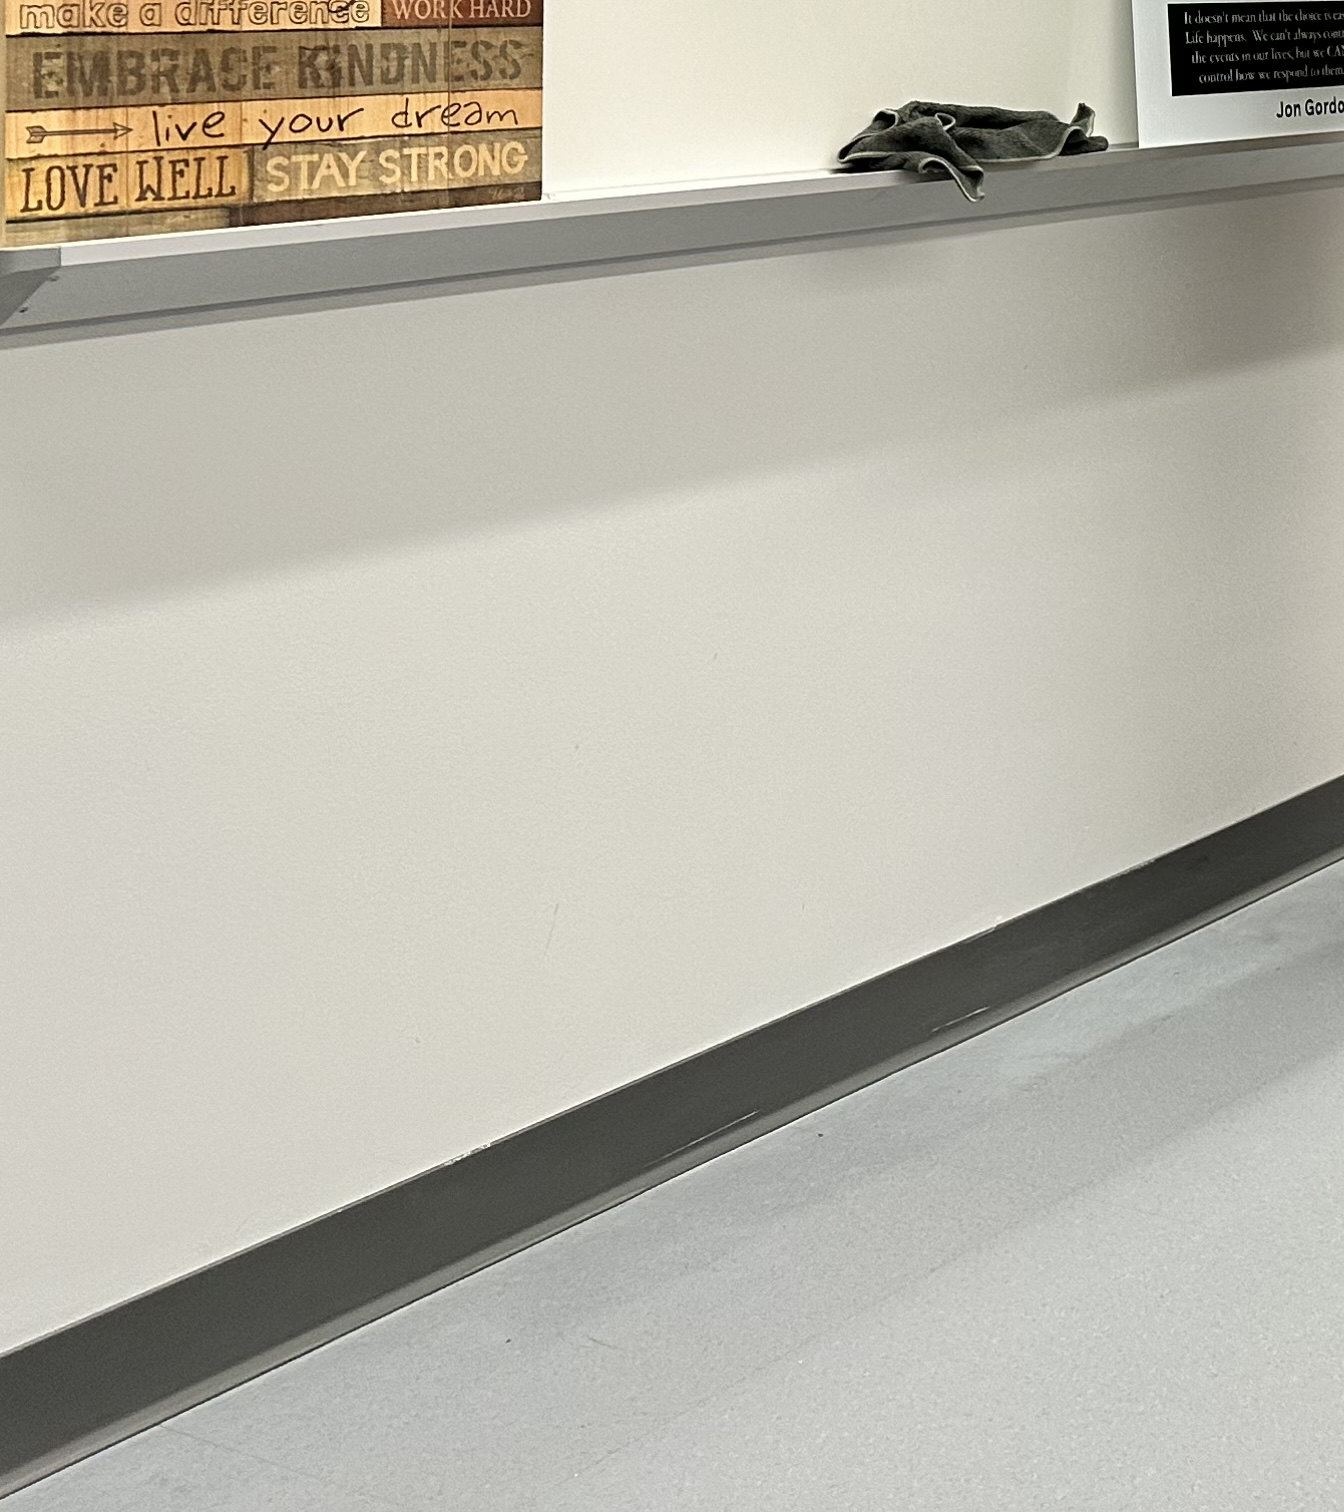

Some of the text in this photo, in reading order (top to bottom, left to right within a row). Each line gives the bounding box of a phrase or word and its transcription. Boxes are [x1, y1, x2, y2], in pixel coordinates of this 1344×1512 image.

[140, 3, 162, 27] a
[1232, 14, 1256, 23] mean
[1259, 10, 1275, 22] that
[1279, 9, 1293, 22] the
[1295, 9, 1322, 21] choice
[1186, 31, 1204, 44] Life
[1252, 29, 1268, 41] We
[1192, 51, 1206, 64] the
[1210, 54, 1239, 63] events
[32, 40, 524, 99] EMBRACE KINDNESS
[1199, 69, 1233, 83] control
[1236, 69, 1255, 81] how
[1258, 71, 1270, 79] we
[1274, 64, 1308, 83] respond
[1277, 101, 1301, 118] Jon
[152, 98, 518, 150] live your dream
[266, 141, 528, 192] STAY STRONG
[20, 156, 236, 213] LOVE WELL
